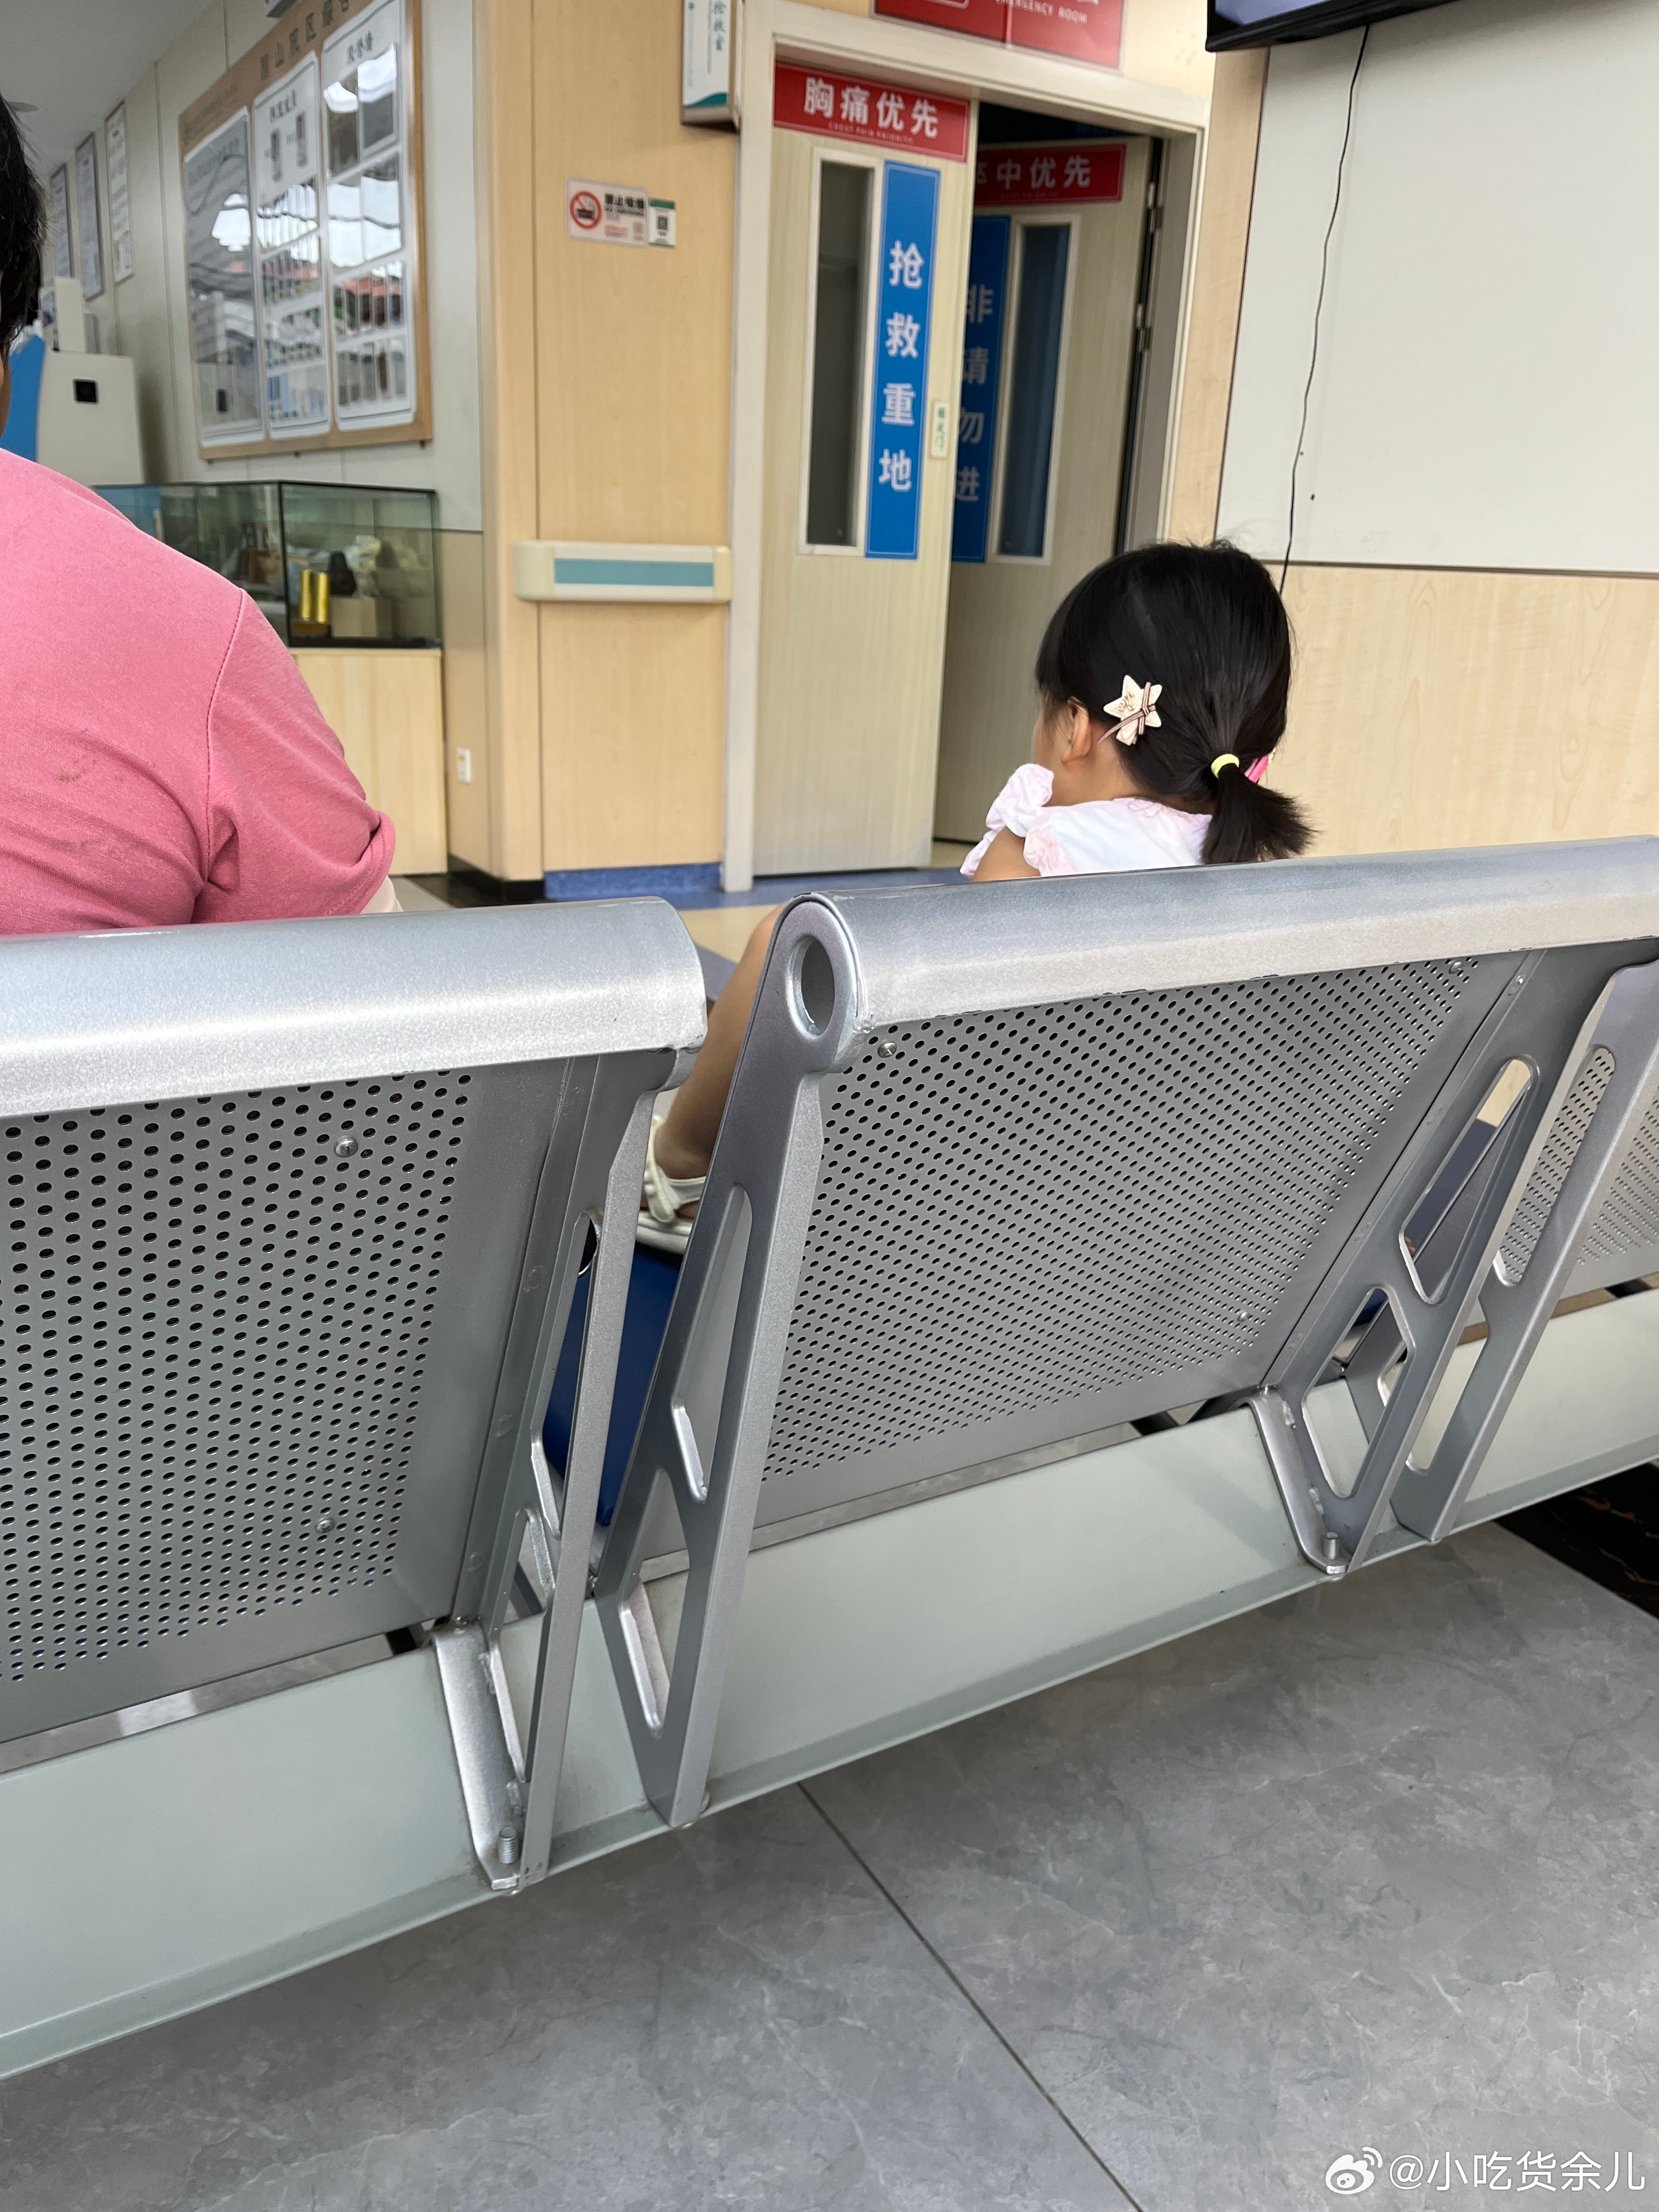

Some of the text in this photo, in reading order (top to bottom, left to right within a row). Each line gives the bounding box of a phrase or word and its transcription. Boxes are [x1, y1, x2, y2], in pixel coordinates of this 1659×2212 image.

[1058, 7, 1087, 23] ROOM
[804, 77, 938, 138] 胸痛优先
[878, 240, 924, 492] 抢救重地
